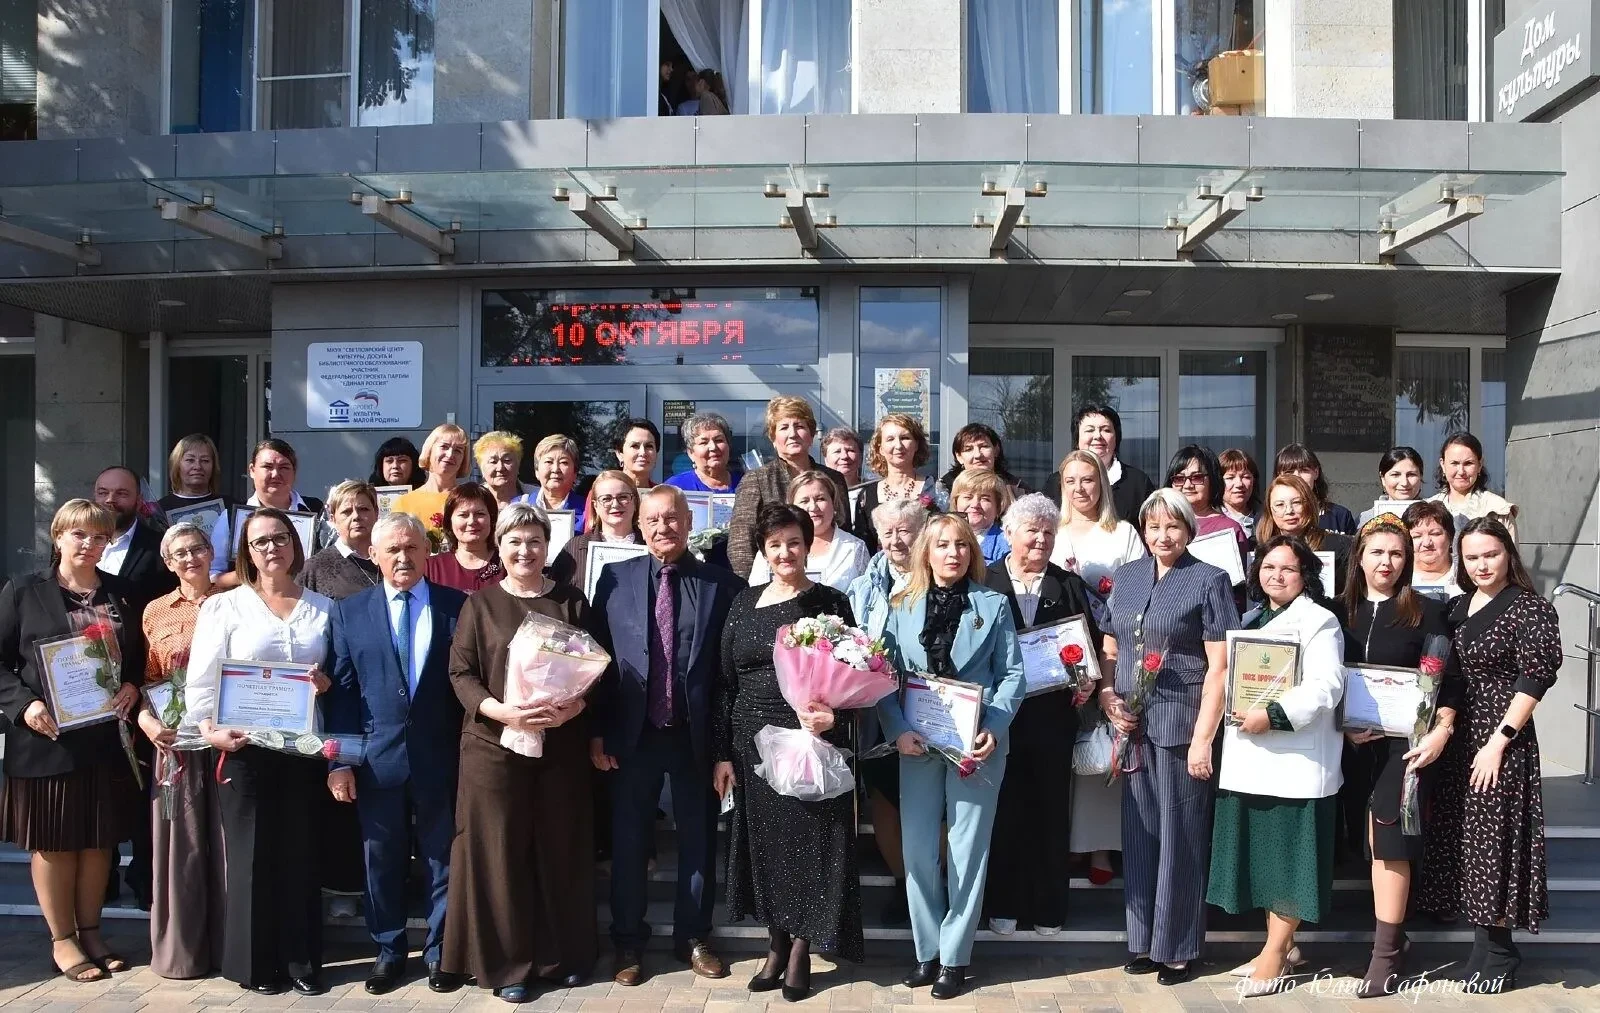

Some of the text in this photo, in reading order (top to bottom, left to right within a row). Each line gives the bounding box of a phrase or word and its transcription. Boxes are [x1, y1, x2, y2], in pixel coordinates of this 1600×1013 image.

[1519, 9, 1556, 66] Дом
[1498, 32, 1581, 116] культуры
[551, 319, 745, 348] 10 ОКТЯБРЯ
